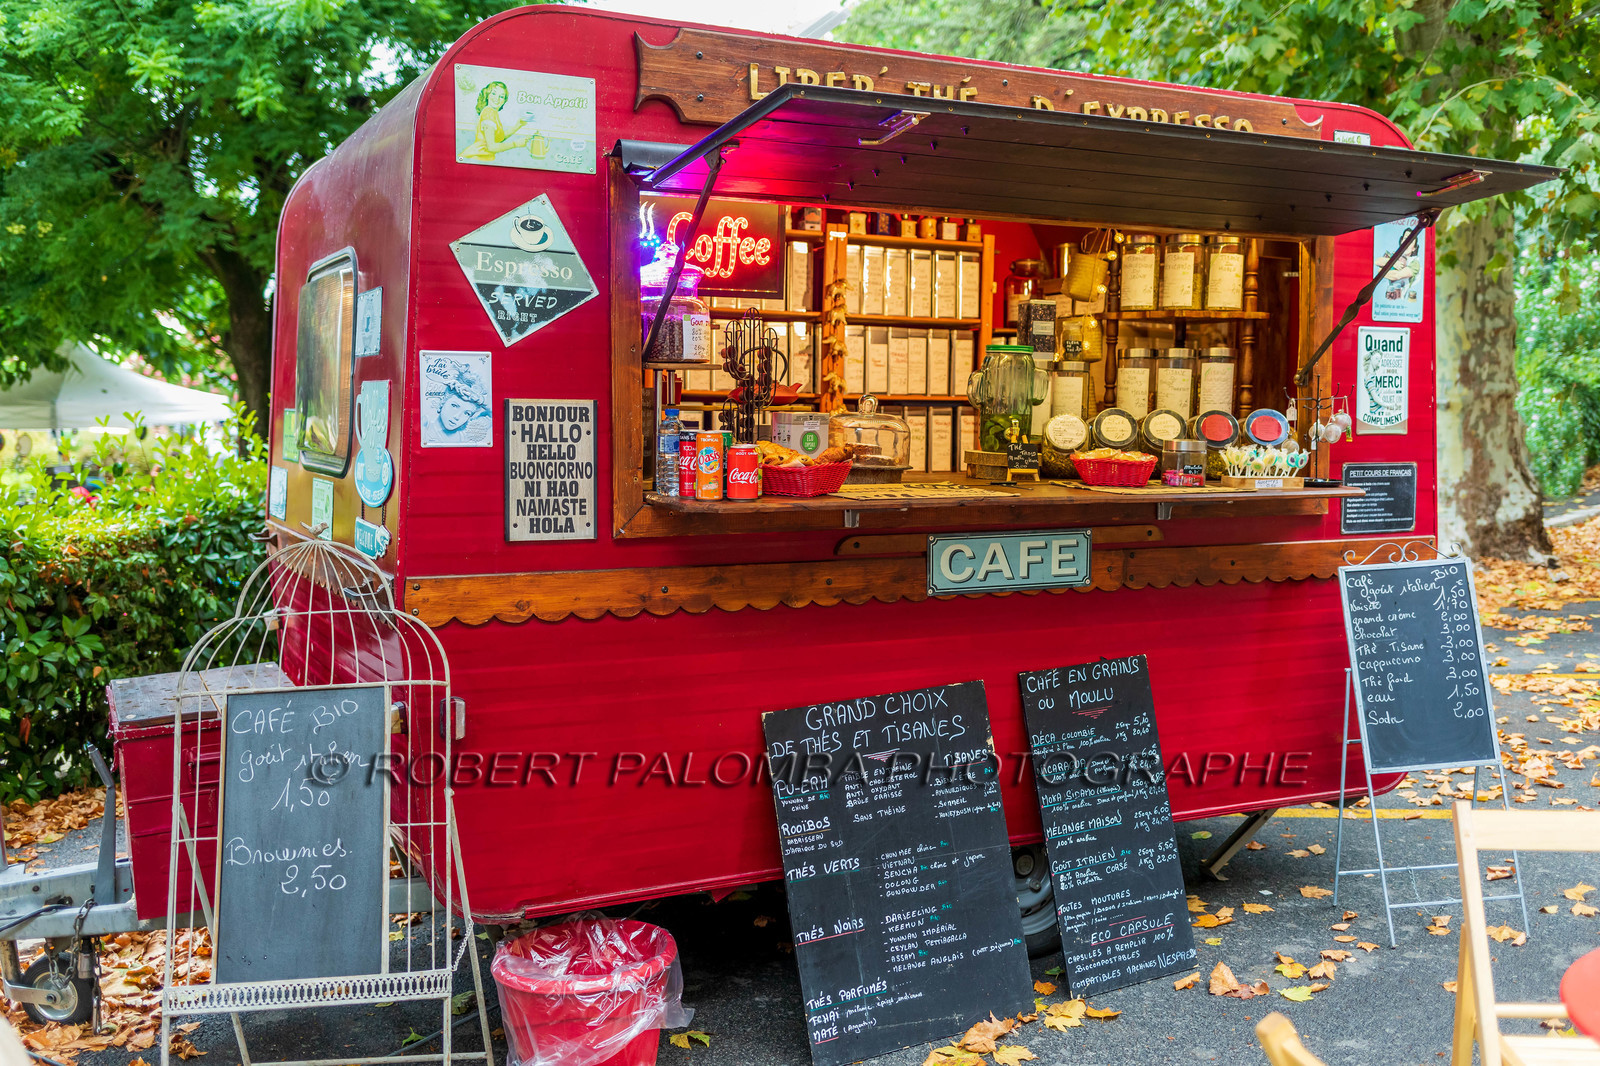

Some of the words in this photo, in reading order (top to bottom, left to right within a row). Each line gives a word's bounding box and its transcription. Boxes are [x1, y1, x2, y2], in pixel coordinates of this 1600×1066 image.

[517, 91, 541, 104] Bon
[544, 94, 588, 109] Appetit
[667, 212, 770, 278] Coffee
[476, 251, 573, 280] Espresso
[488, 291, 558, 309] SERVED
[497, 310, 537, 323] RIGHT
[1365, 334, 1403, 352] Quand
[1375, 376, 1402, 388] MERCI
[512, 406, 590, 422] BONJOUR
[1362, 413, 1402, 426] COMPLIMENT
[521, 424, 582, 443] HALLO
[527, 444, 576, 460] HELLO
[698, 450, 720, 465] Oasis
[510, 462, 593, 479] BUONGIORNO
[524, 481, 541, 497] NI
[547, 481, 579, 497] HAO
[516, 498, 587, 516] NAMASTE
[529, 517, 575, 534] HOLA
[940, 539, 1079, 583] CAFE
[1400, 578, 1441, 596] italien
[1353, 612, 1384, 631] grand
[1026, 669, 1061, 693] CAFÉ
[1068, 667, 1087, 684] EN
[1092, 657, 1140, 680] GRAINS
[1387, 673, 1414, 692] froid
[1038, 698, 1055, 710] OU
[1069, 687, 1114, 709] MOULU
[1367, 694, 1396, 703] eau
[1447, 683, 1479, 700] 1,50
[232, 700, 295, 735] CAFÉ
[309, 699, 359, 735] BIO
[805, 699, 876, 731] GRAND
[885, 689, 948, 715] CHOIX
[1367, 710, 1404, 726] Soda
[771, 740, 796, 759] DE
[800, 730, 843, 755] THÉS
[853, 729, 871, 749] ET
[882, 714, 966, 744] TISANES
[1031, 730, 1056, 746] DÉCA
[238, 743, 292, 782] goût
[944, 749, 988, 766] TISANES
[271, 778, 330, 813] 1,50
[774, 774, 828, 799] PU-ERH
[846, 791, 864, 800] ANTI
[1041, 792, 1062, 805] MOKA
[853, 813, 873, 823] SANS
[1046, 821, 1085, 838] MÉLANGE
[1088, 809, 1123, 829] MAISON
[786, 861, 816, 881] THÉS
[823, 857, 860, 874] VERTS
[884, 867, 918, 880] SENCHA
[1106, 857, 1129, 874] CORSÉ
[281, 864, 347, 898] 2,50
[885, 877, 919, 889] OOLONG
[886, 882, 936, 897] GUNPOWDER
[1058, 901, 1083, 914] TOUTES
[1091, 889, 1131, 906] MOUTURES
[796, 924, 825, 943] THÉS
[834, 917, 864, 934] NOIRS
[888, 918, 924, 933] KEEMUN
[1090, 929, 1111, 945] ECO
[1120, 912, 1174, 936] CAPSULE
[890, 942, 919, 953] CEYLAN
[1067, 950, 1102, 964] CAPSULES
[1152, 926, 1174, 944] 100%
[891, 952, 916, 963] ASSAM
[930, 951, 964, 966] ANGLAIS
[806, 991, 833, 1010] THÉS
[838, 977, 887, 1001] PARFUMÉS
